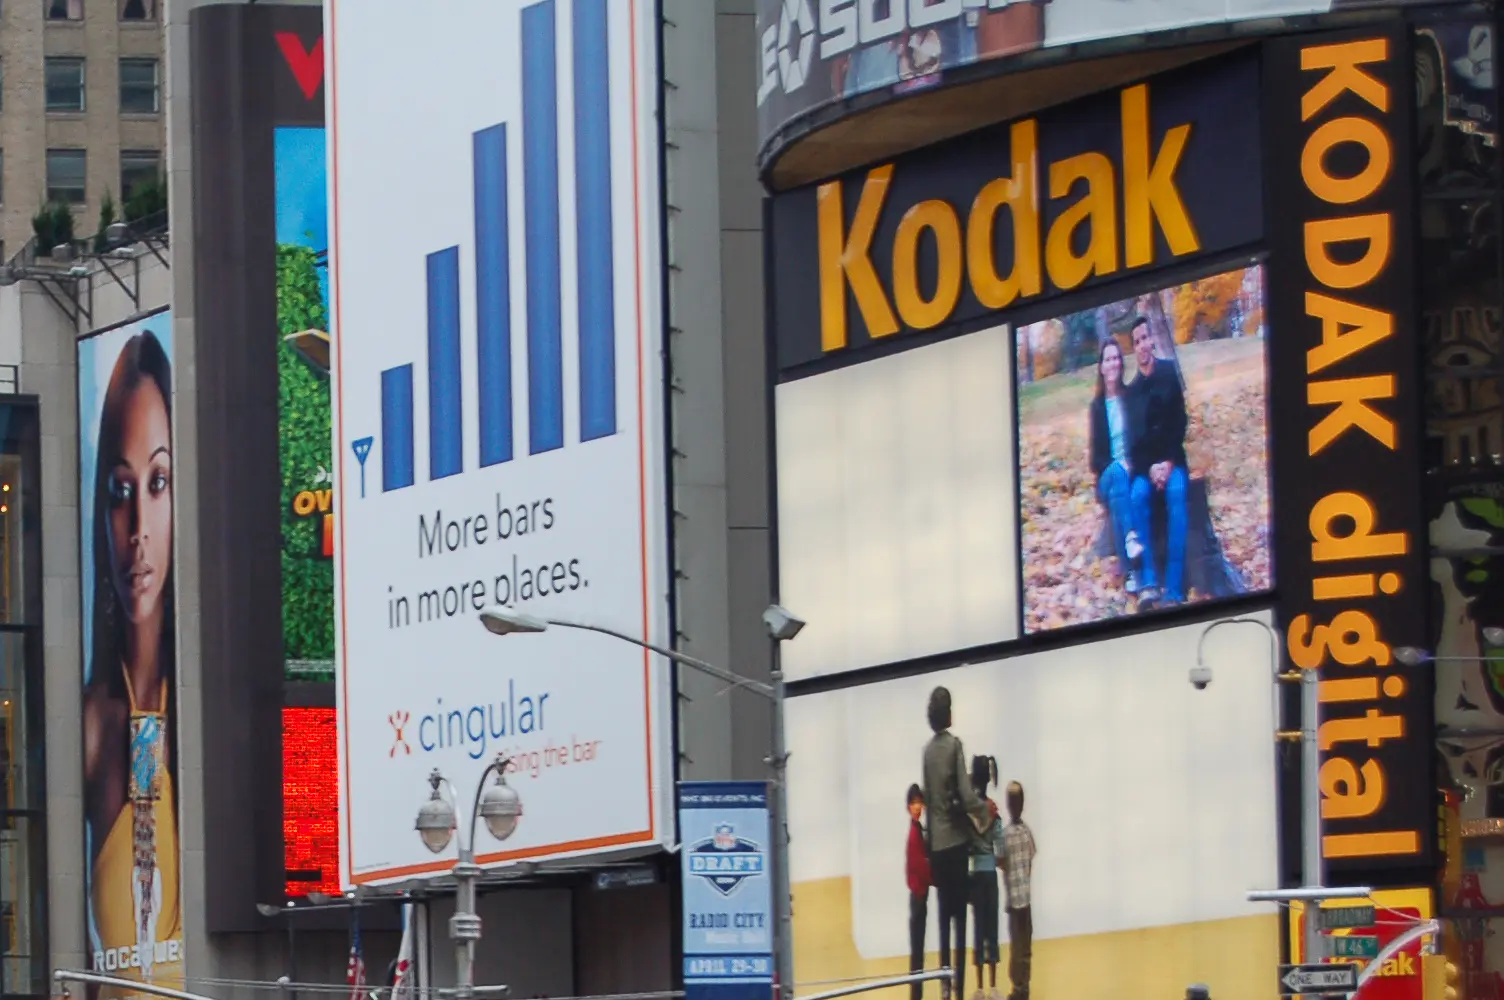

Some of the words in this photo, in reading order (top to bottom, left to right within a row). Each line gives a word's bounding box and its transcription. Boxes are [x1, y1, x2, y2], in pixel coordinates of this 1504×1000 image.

[817, 84, 1202, 353] Kodak
[1300, 37, 1396, 455] KODAK
[419, 509, 488, 558] More
[496, 493, 554, 540] bars
[388, 585, 410, 629] in
[418, 579, 486, 623] more
[495, 553, 589, 609] places.
[1288, 490, 1422, 859] digital
[420, 678, 549, 760] cingular
[691, 854, 762, 872] DRAFT
[689, 912, 728, 929] RADIO
[733, 912, 765, 929] CITY
[1289, 974, 1314, 987] ONE
[1322, 972, 1346, 986] WAY
